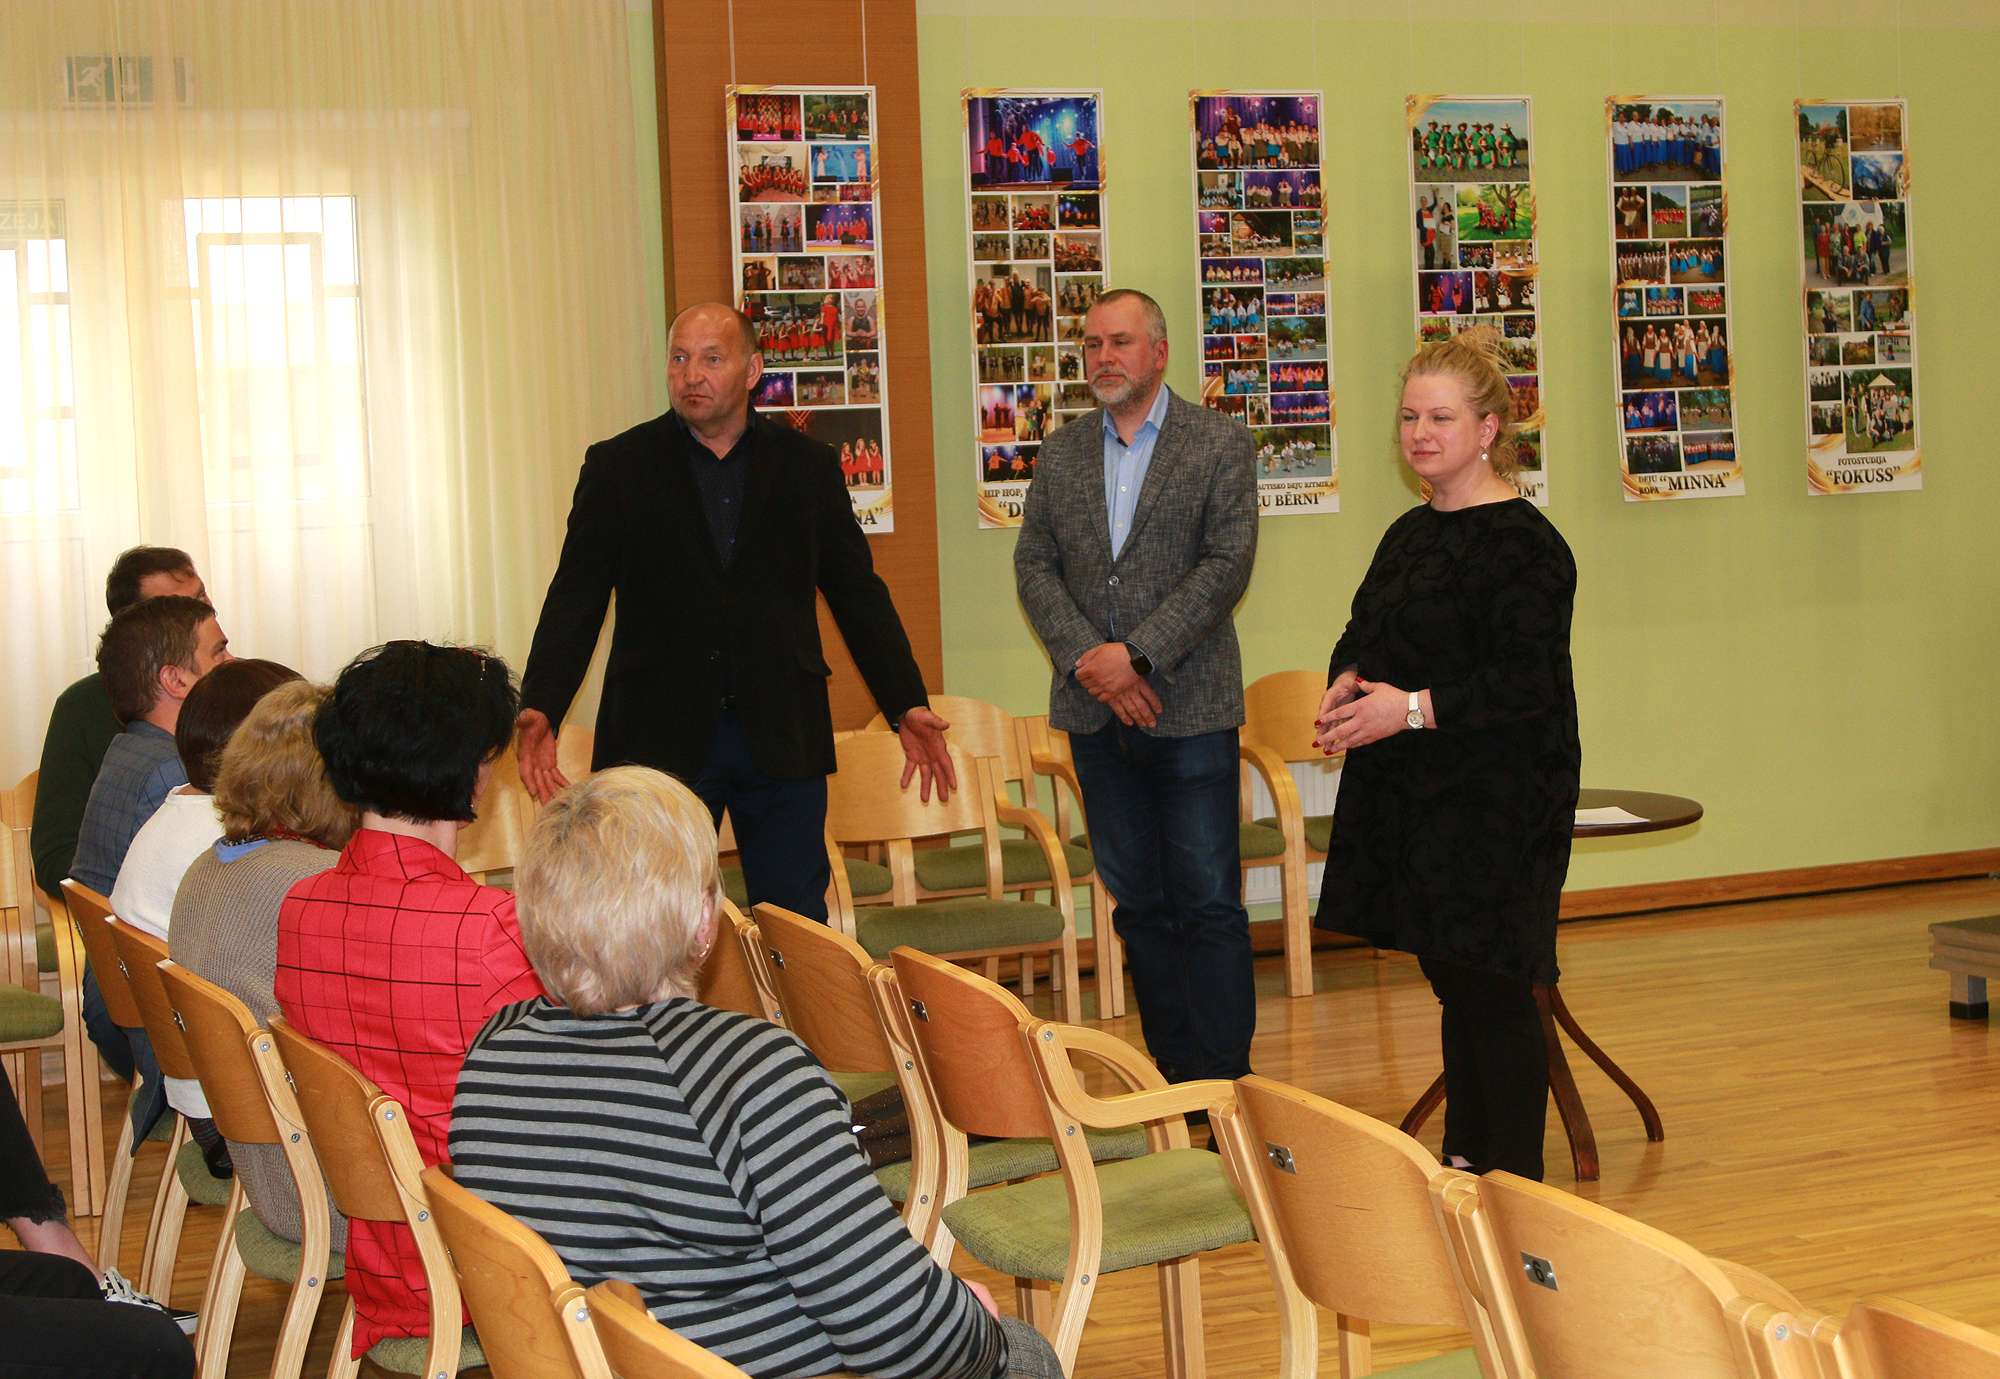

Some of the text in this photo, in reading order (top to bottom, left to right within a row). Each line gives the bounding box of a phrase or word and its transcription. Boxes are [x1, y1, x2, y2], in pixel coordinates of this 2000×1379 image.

[0, 213, 57, 230] ZEJA
[1838, 456, 1887, 465] FOTOSTUDIJA
[1660, 472, 1730, 490] “MINNA”
[1826, 465, 1900, 485] “FOKUSS”
[1304, 480, 1334, 488] RITMIKA
[1640, 486, 1660, 495] KOPA
[984, 490, 1000, 498] HIP
[1002, 488, 1023, 498] HOP,
[1275, 491, 1325, 507] BĒRNI”
[854, 507, 884, 525] NA”
[1274, 1148, 1285, 1168] 5
[1532, 1260, 1545, 1283] 6
